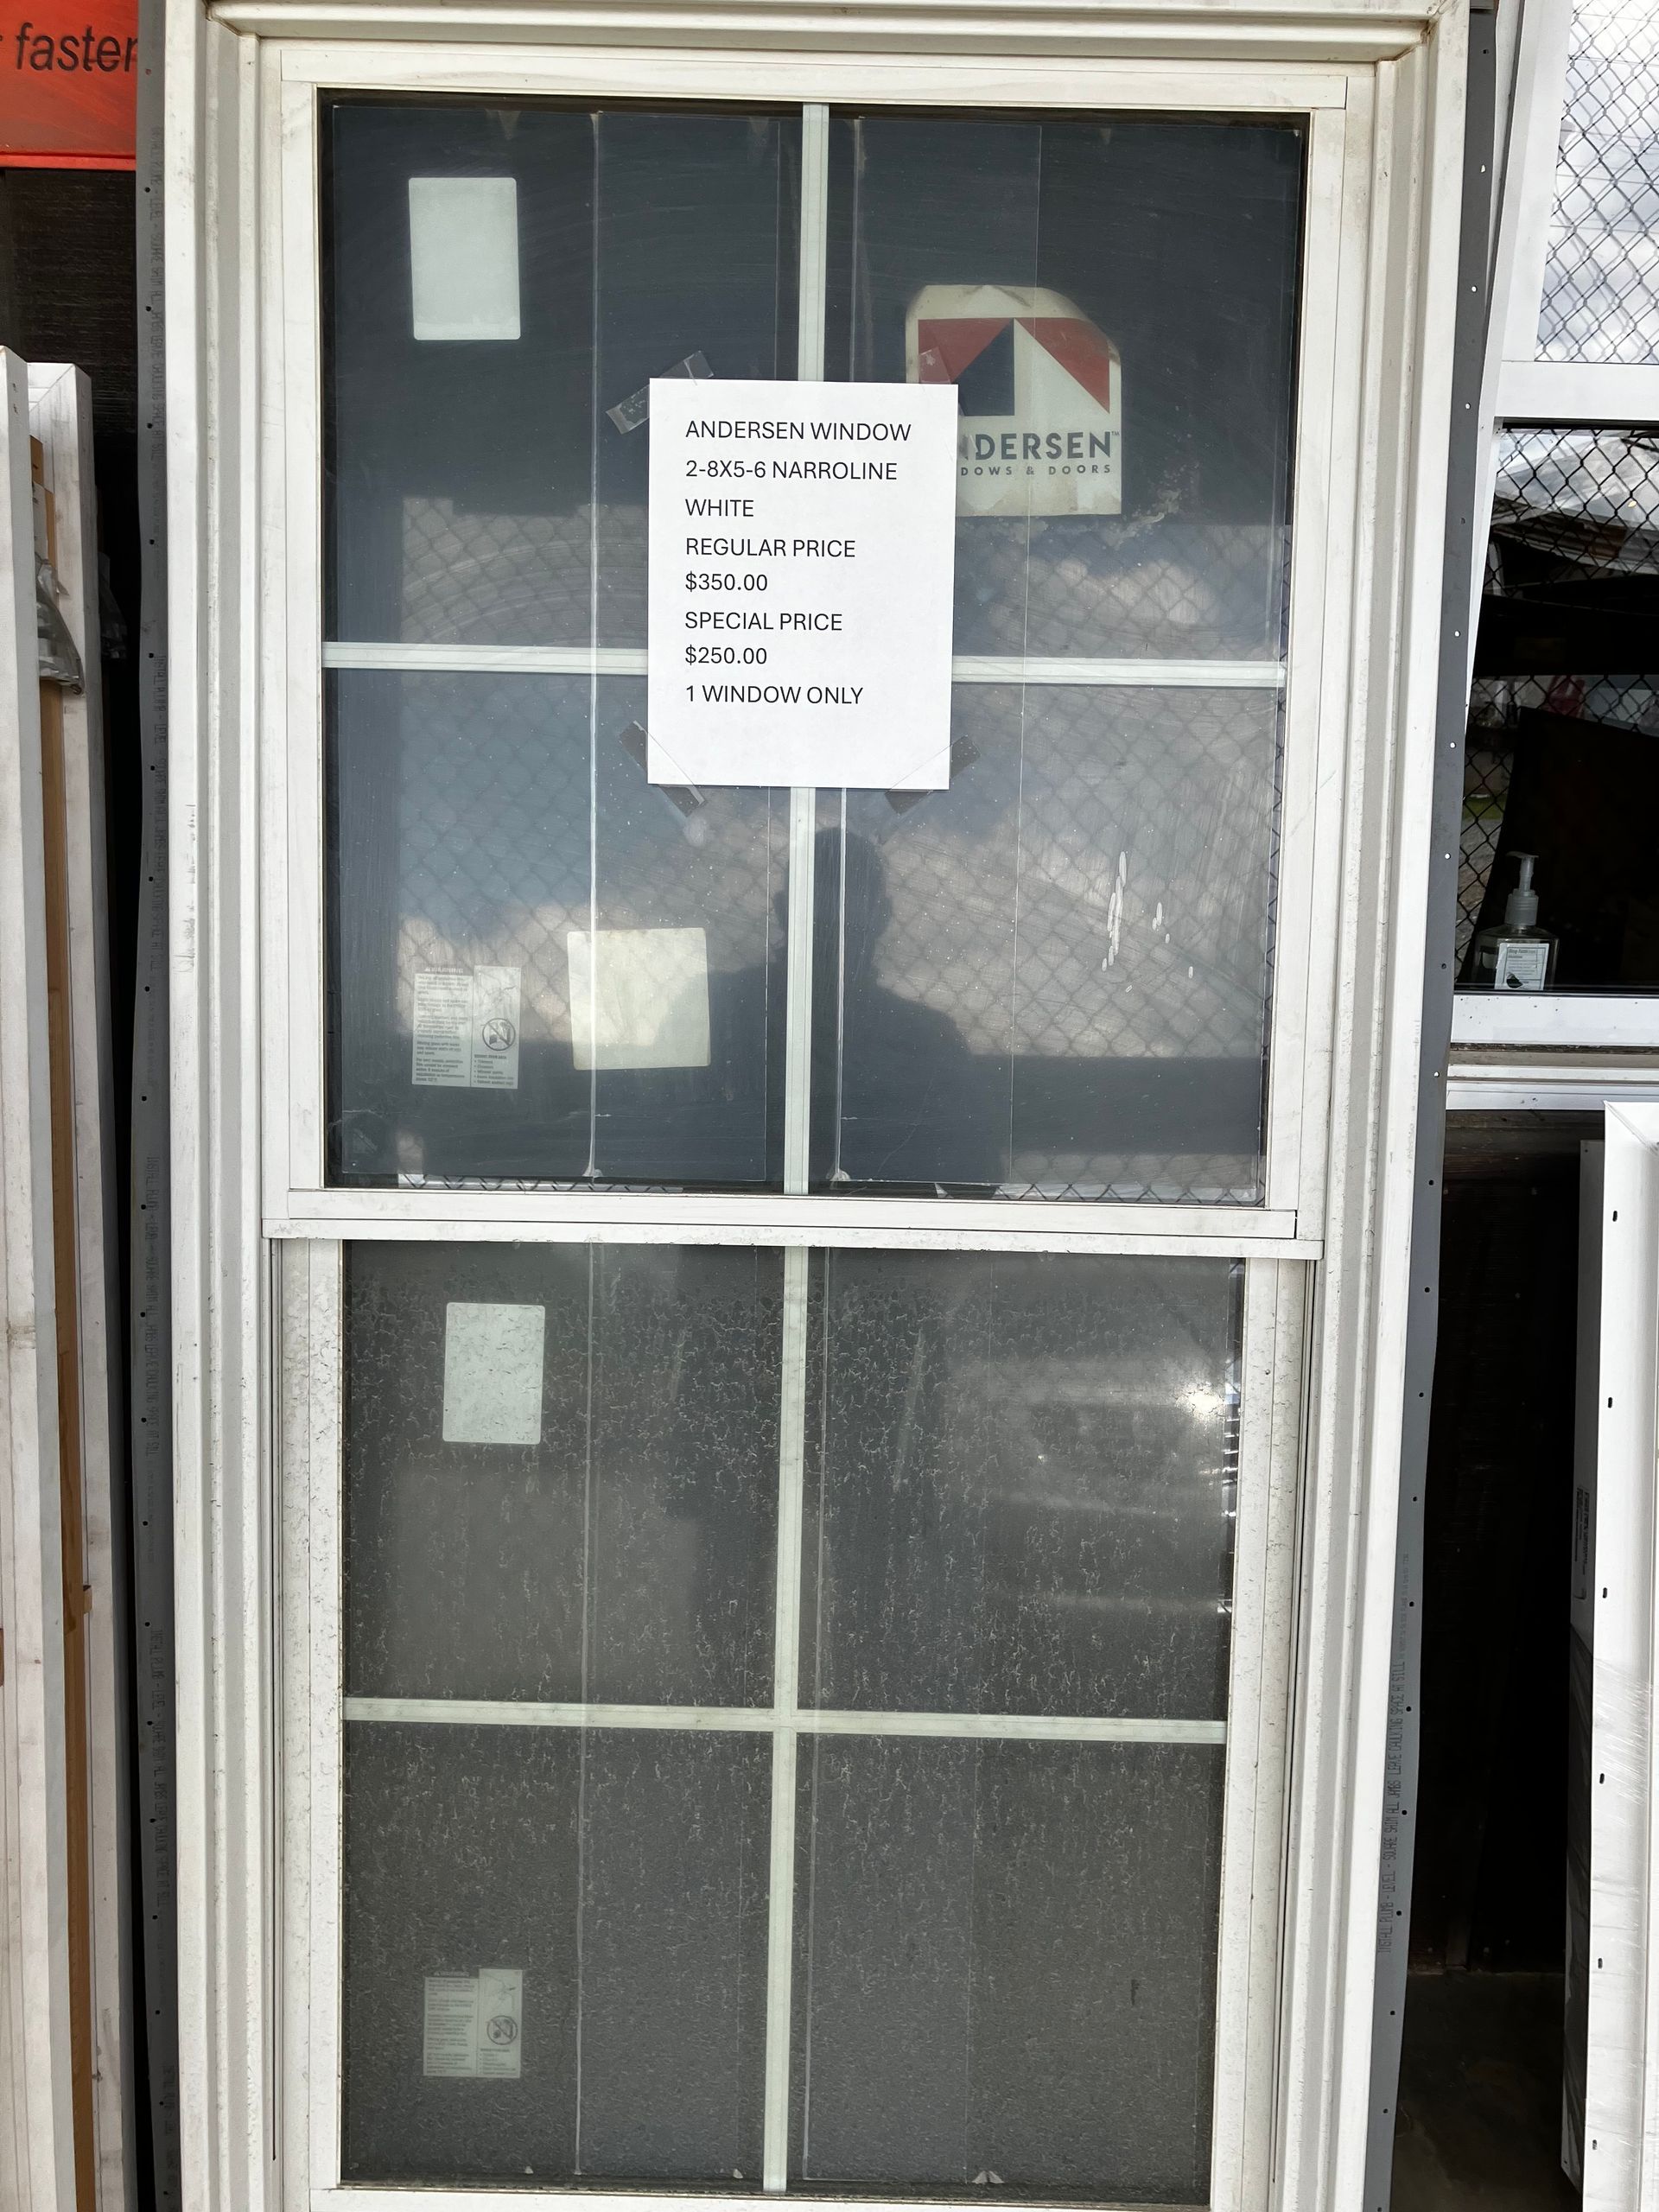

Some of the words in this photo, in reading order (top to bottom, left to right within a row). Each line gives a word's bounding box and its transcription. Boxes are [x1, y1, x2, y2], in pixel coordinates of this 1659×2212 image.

[16, 22, 138, 73] faster
[686, 421, 804, 439] ANDERSEN
[810, 423, 911, 441] WINDOW
[959, 431, 1111, 461] DERSEN
[686, 461, 766, 478] 2-8X5-6
[773, 461, 897, 480] NARROLINE
[961, 465, 1013, 476] DOWS
[1048, 464, 1111, 475] DOORS
[685, 499, 753, 517] WHITE
[687, 538, 785, 556] REGULAR
[794, 540, 855, 556] PRICE
[686, 571, 767, 592] $350.00
[686, 612, 773, 629] SPECIAL
[780, 613, 842, 630] PRICE
[685, 645, 766, 665] $250.00
[687, 686, 693, 702] 1
[702, 685, 801, 702] WINDOW
[807, 687, 863, 703] ONLY
[1392, 1662, 1405, 1681] SILL
[1384, 1802, 1400, 1815] ALL
[1381, 1872, 1396, 1892] LEVEL
[1379, 1903, 1394, 1923] PLUMB
[1377, 1926, 1392, 1954] INSTALL
